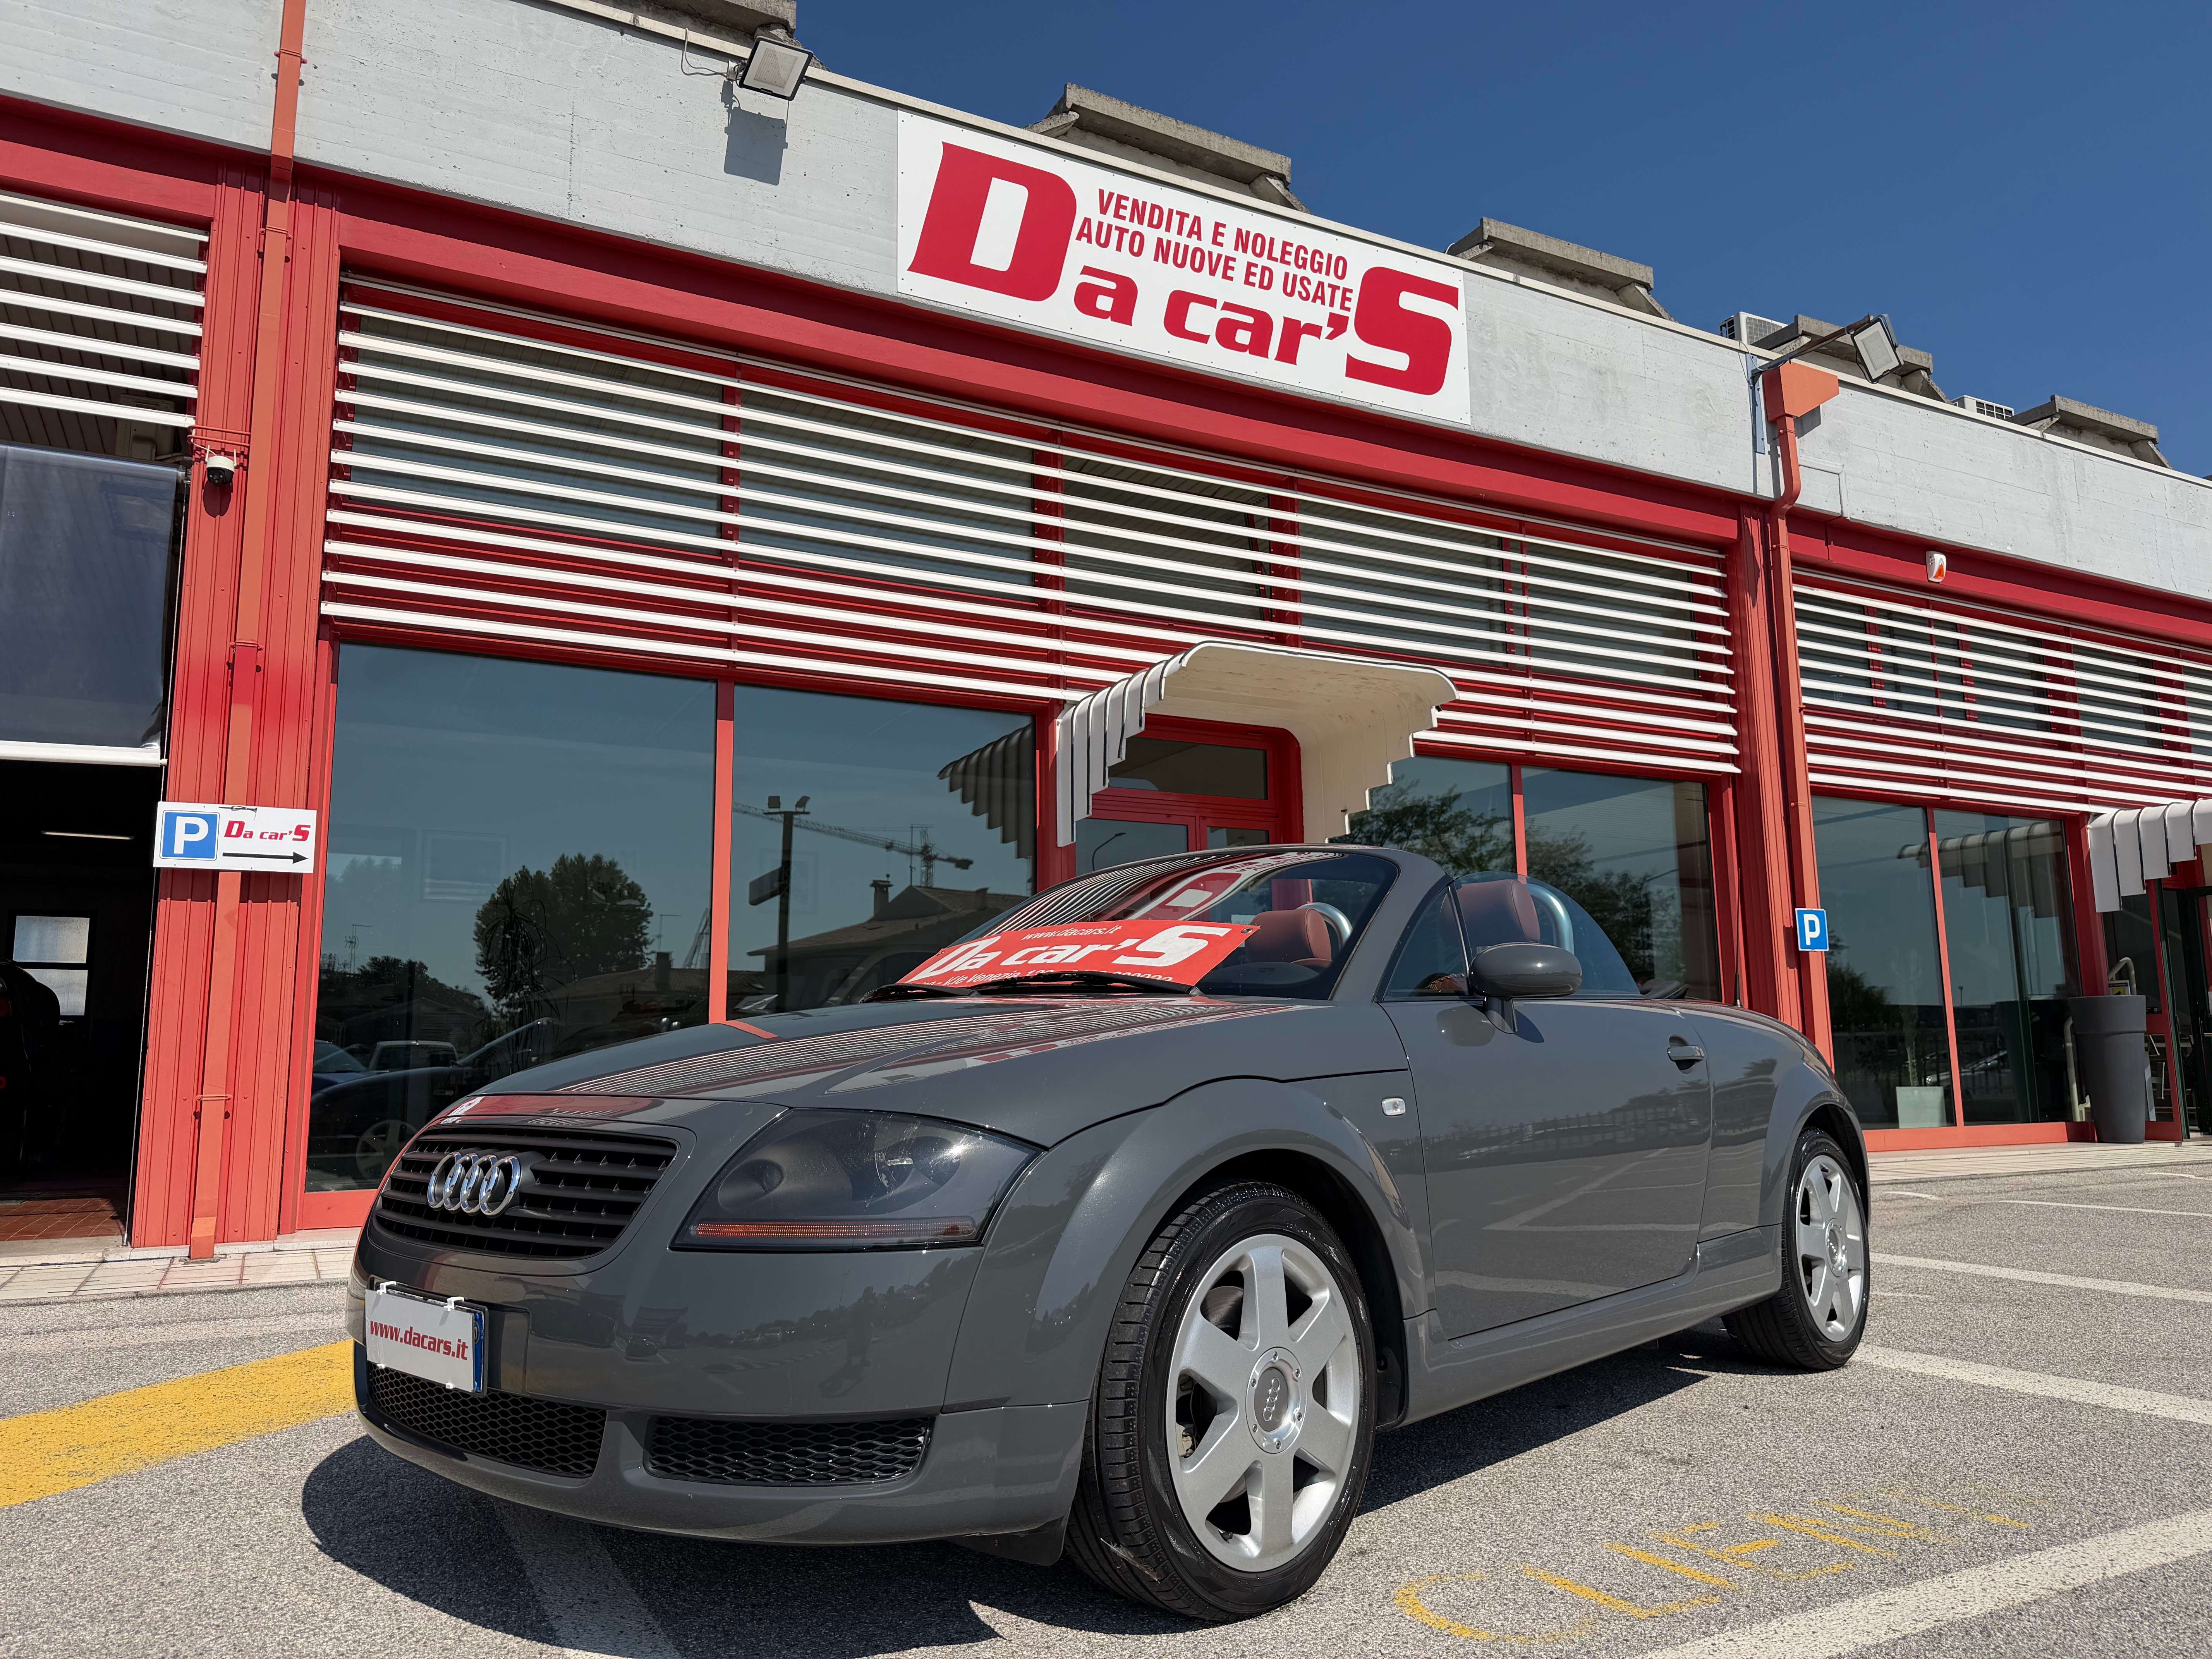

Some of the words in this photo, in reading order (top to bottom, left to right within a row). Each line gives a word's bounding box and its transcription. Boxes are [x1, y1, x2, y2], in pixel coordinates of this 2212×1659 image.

[1098, 189, 1202, 241] VENDITA
[1211, 221, 1226, 247] E
[1234, 227, 1348, 280] NOLEGGIO
[907, 142, 1139, 326] Da
[1163, 266, 1459, 396] car'S
[1075, 217, 1145, 258] AUTO
[1154, 237, 1237, 281] NUOVE
[1243, 261, 1274, 291] ED
[1282, 272, 1353, 312] USATE
[173, 816, 209, 854] P
[224, 820, 253, 839] Da
[259, 824, 311, 842] car'S
[1021, 925, 1122, 940] www.dacars.it
[1803, 914, 1820, 945] P
[904, 935, 1002, 984] Da
[370, 1320, 468, 1360] www.dacars.it
